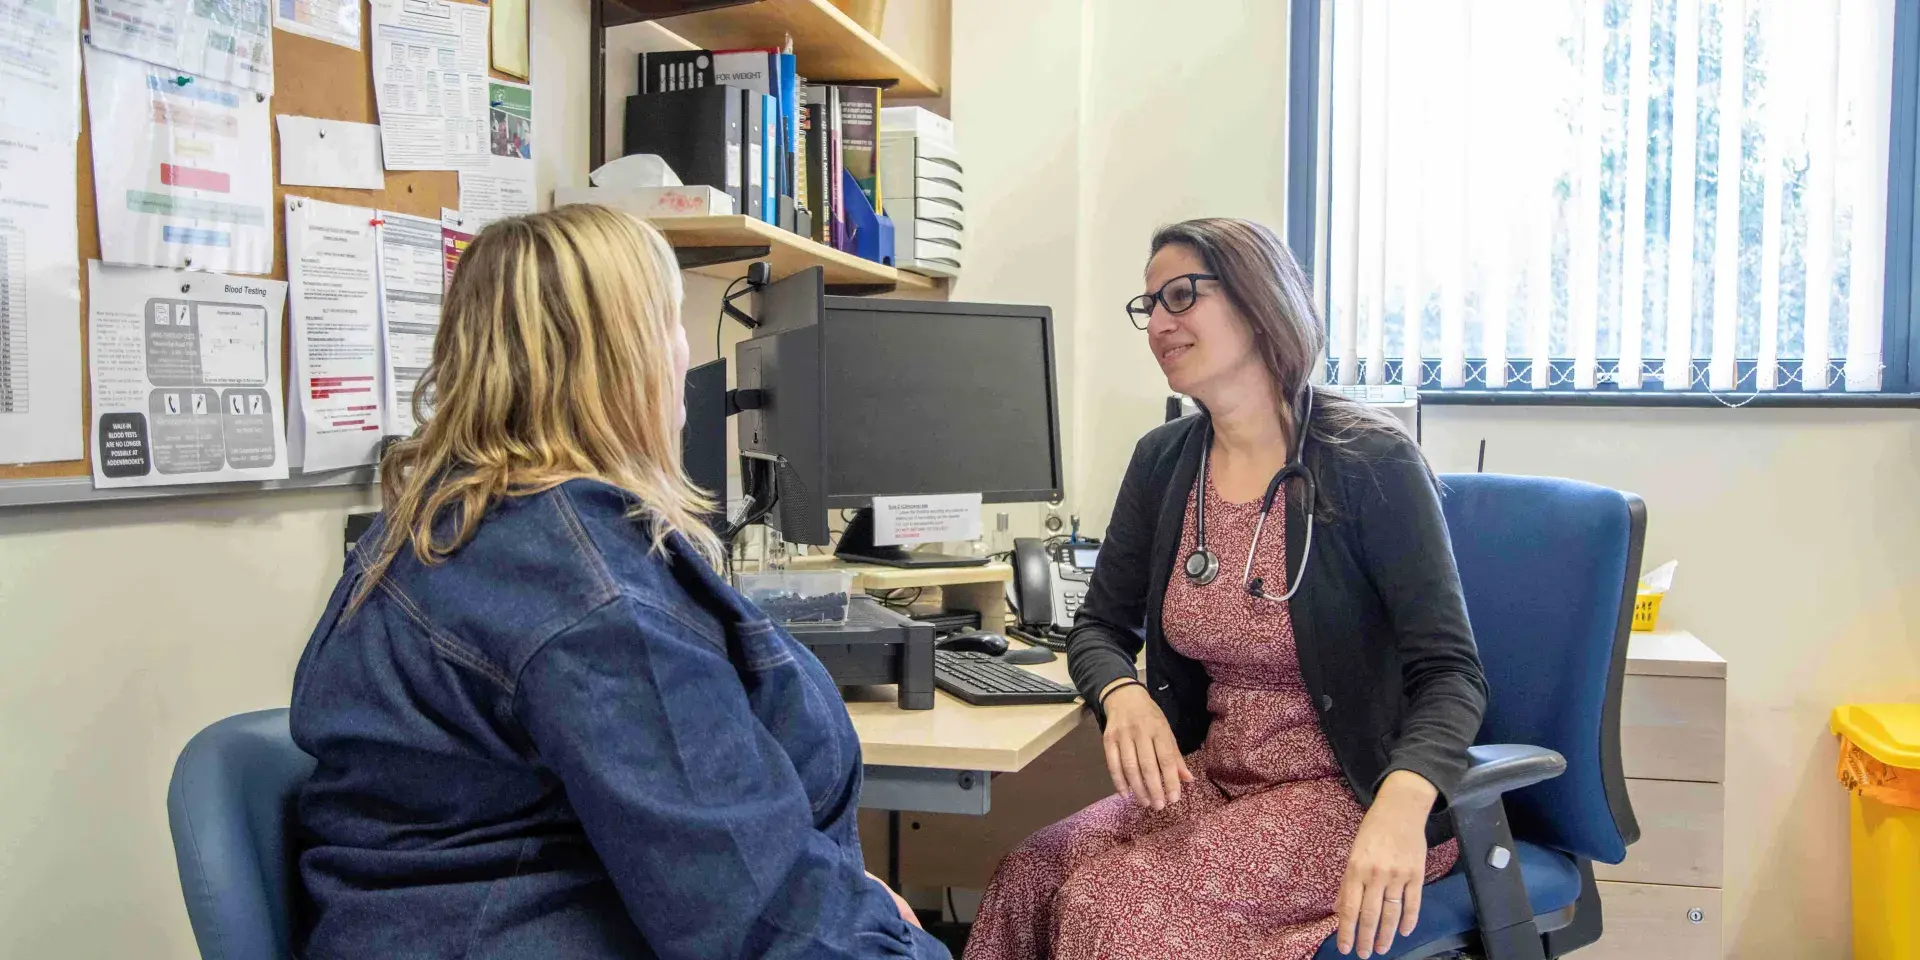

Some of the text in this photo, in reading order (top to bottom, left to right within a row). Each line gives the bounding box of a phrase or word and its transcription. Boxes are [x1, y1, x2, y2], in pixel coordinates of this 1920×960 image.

[732, 71, 762, 80] WEIGHT
[224, 284, 267, 298] Blood Testing
